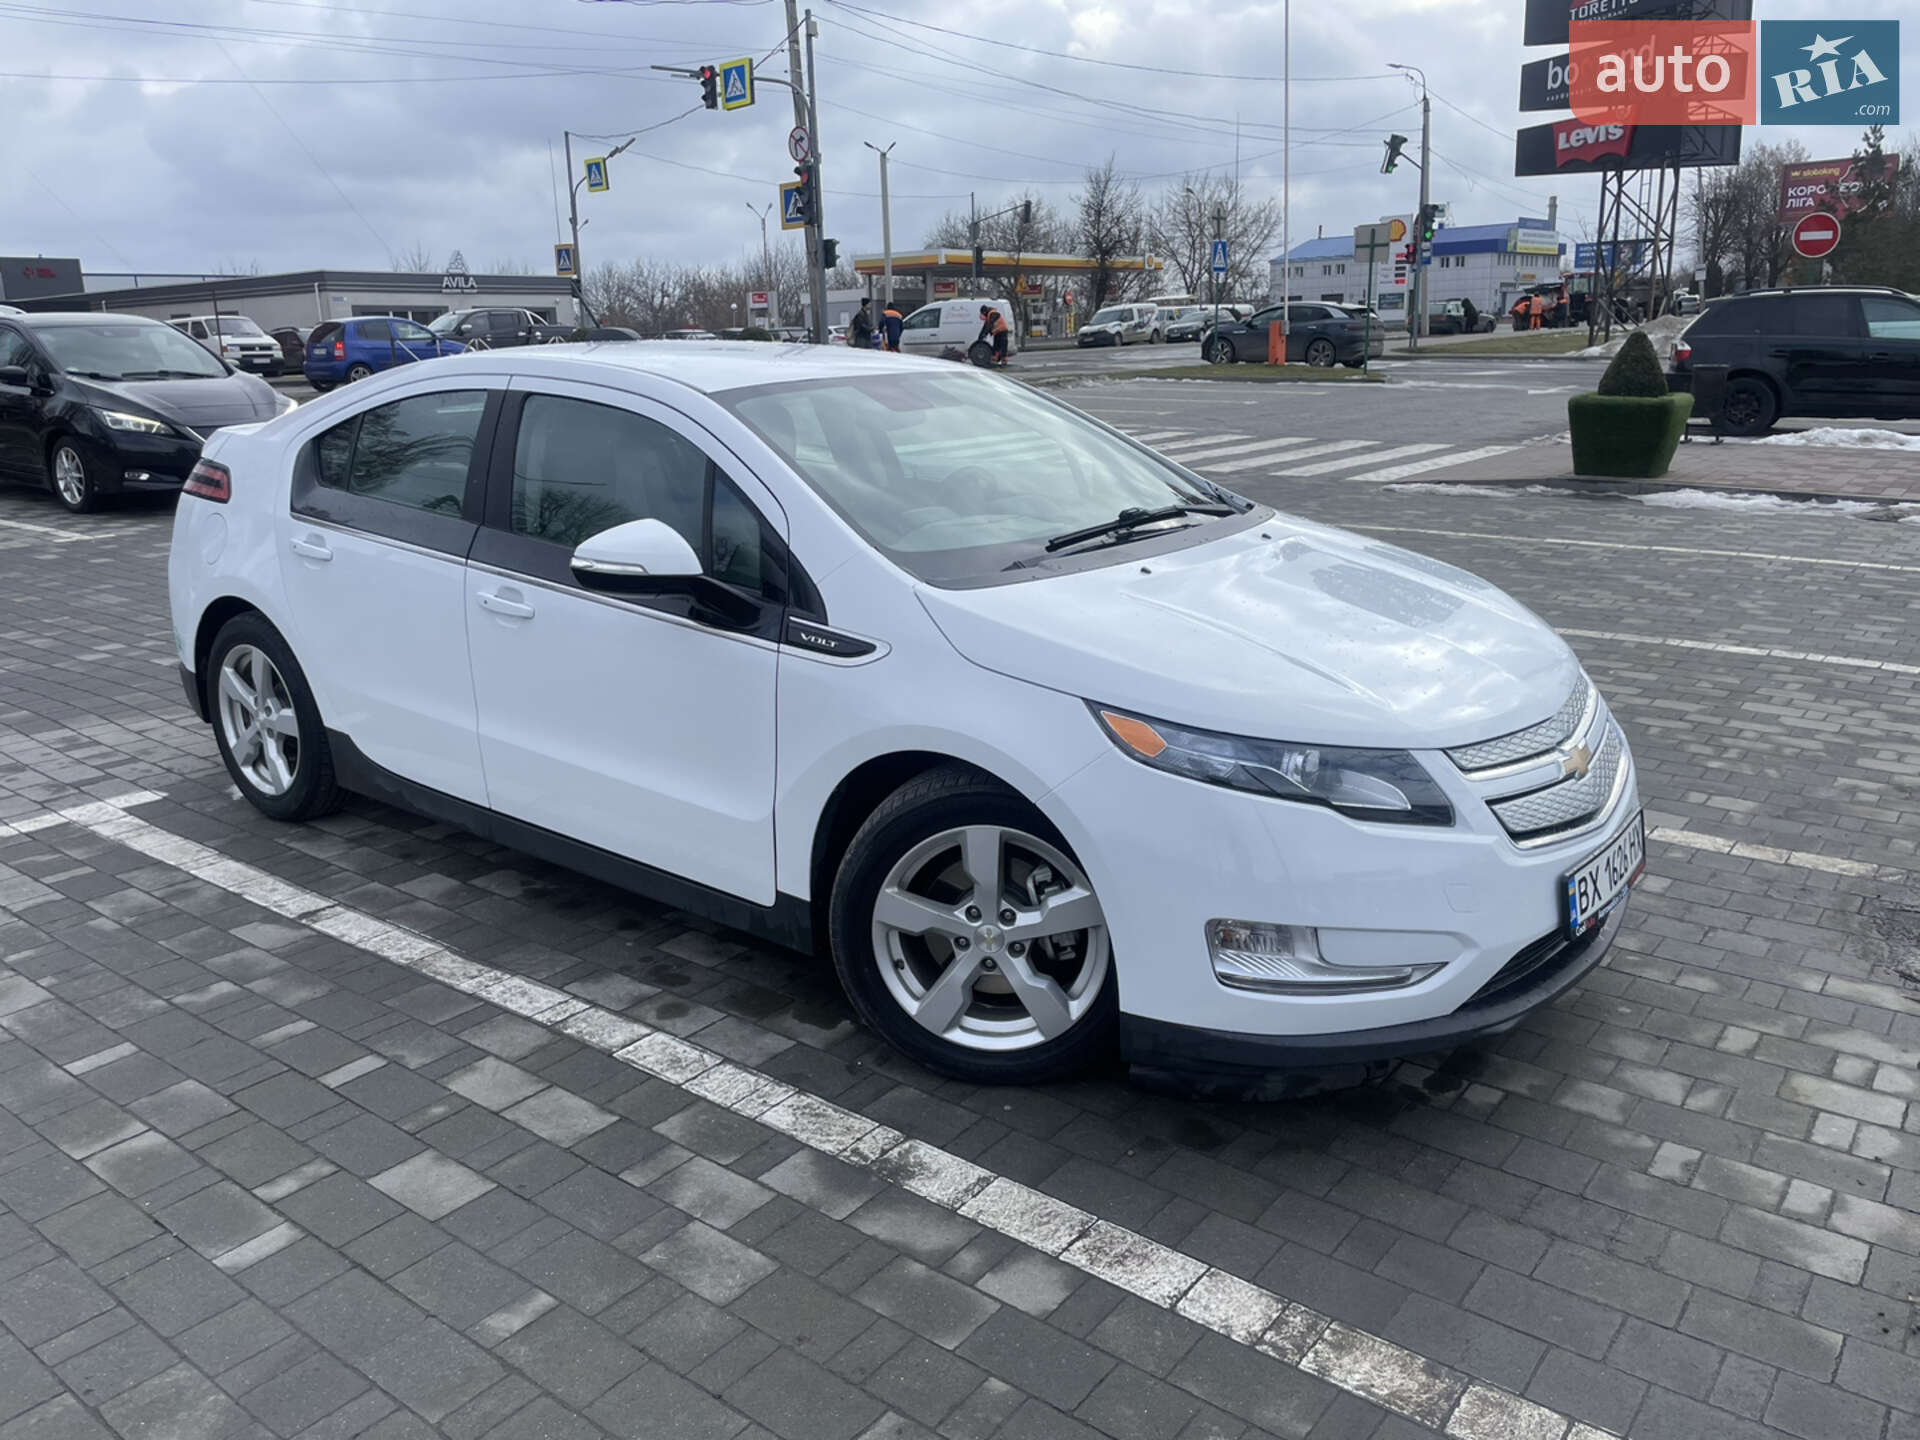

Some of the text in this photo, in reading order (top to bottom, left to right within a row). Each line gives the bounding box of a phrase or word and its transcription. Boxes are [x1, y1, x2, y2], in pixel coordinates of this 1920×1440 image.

[1786, 197, 1815, 208] ЛІГА
[442, 276, 478, 288] AVILA
[800, 632, 839, 648] VOLT
[1578, 866, 1602, 916] BX
[1605, 838, 1629, 892] 1626
